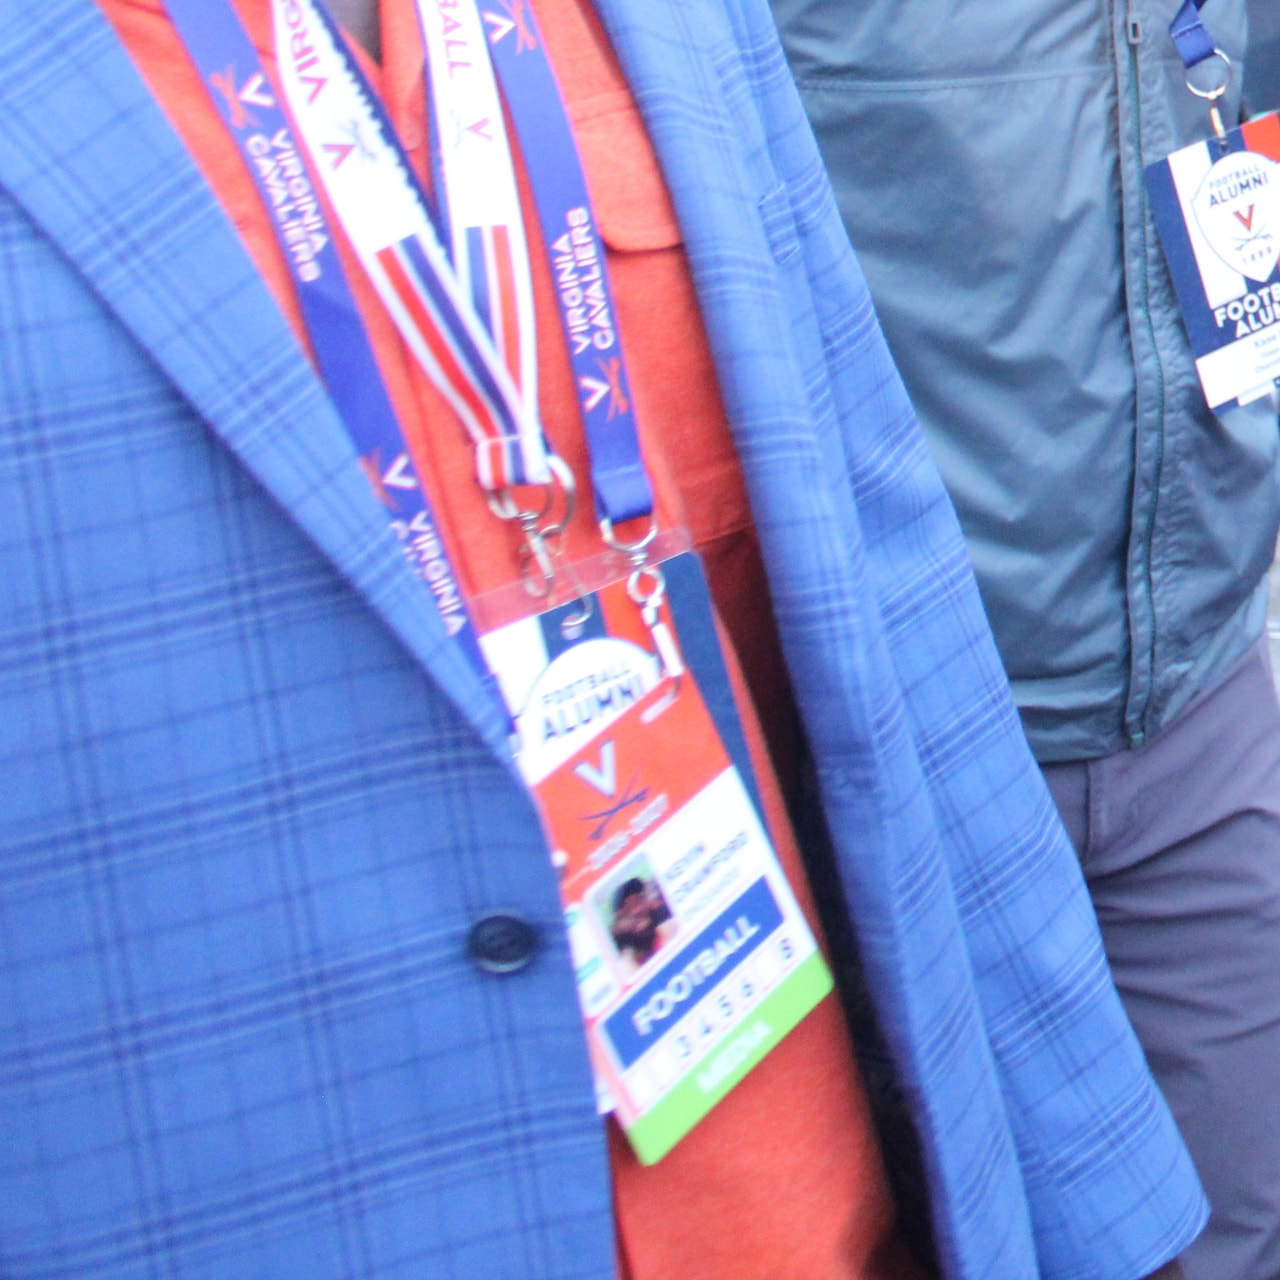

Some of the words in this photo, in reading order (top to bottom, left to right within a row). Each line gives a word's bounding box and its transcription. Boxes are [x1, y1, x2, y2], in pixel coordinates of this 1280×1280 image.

[245, 133, 322, 283] CAVALIERS
[270, 127, 330, 254] VIRGINIA
[1208, 172, 1269, 209] ALUMNI
[1209, 163, 1261, 189] FOOTBALL
[552, 233, 592, 355] VIRGINIA
[565, 206, 616, 350] CAVALIERS
[408, 509, 467, 637] VIRGINIA
[542, 673, 643, 745] ALUMNI
[631, 915, 761, 1037] FOOTBALL
